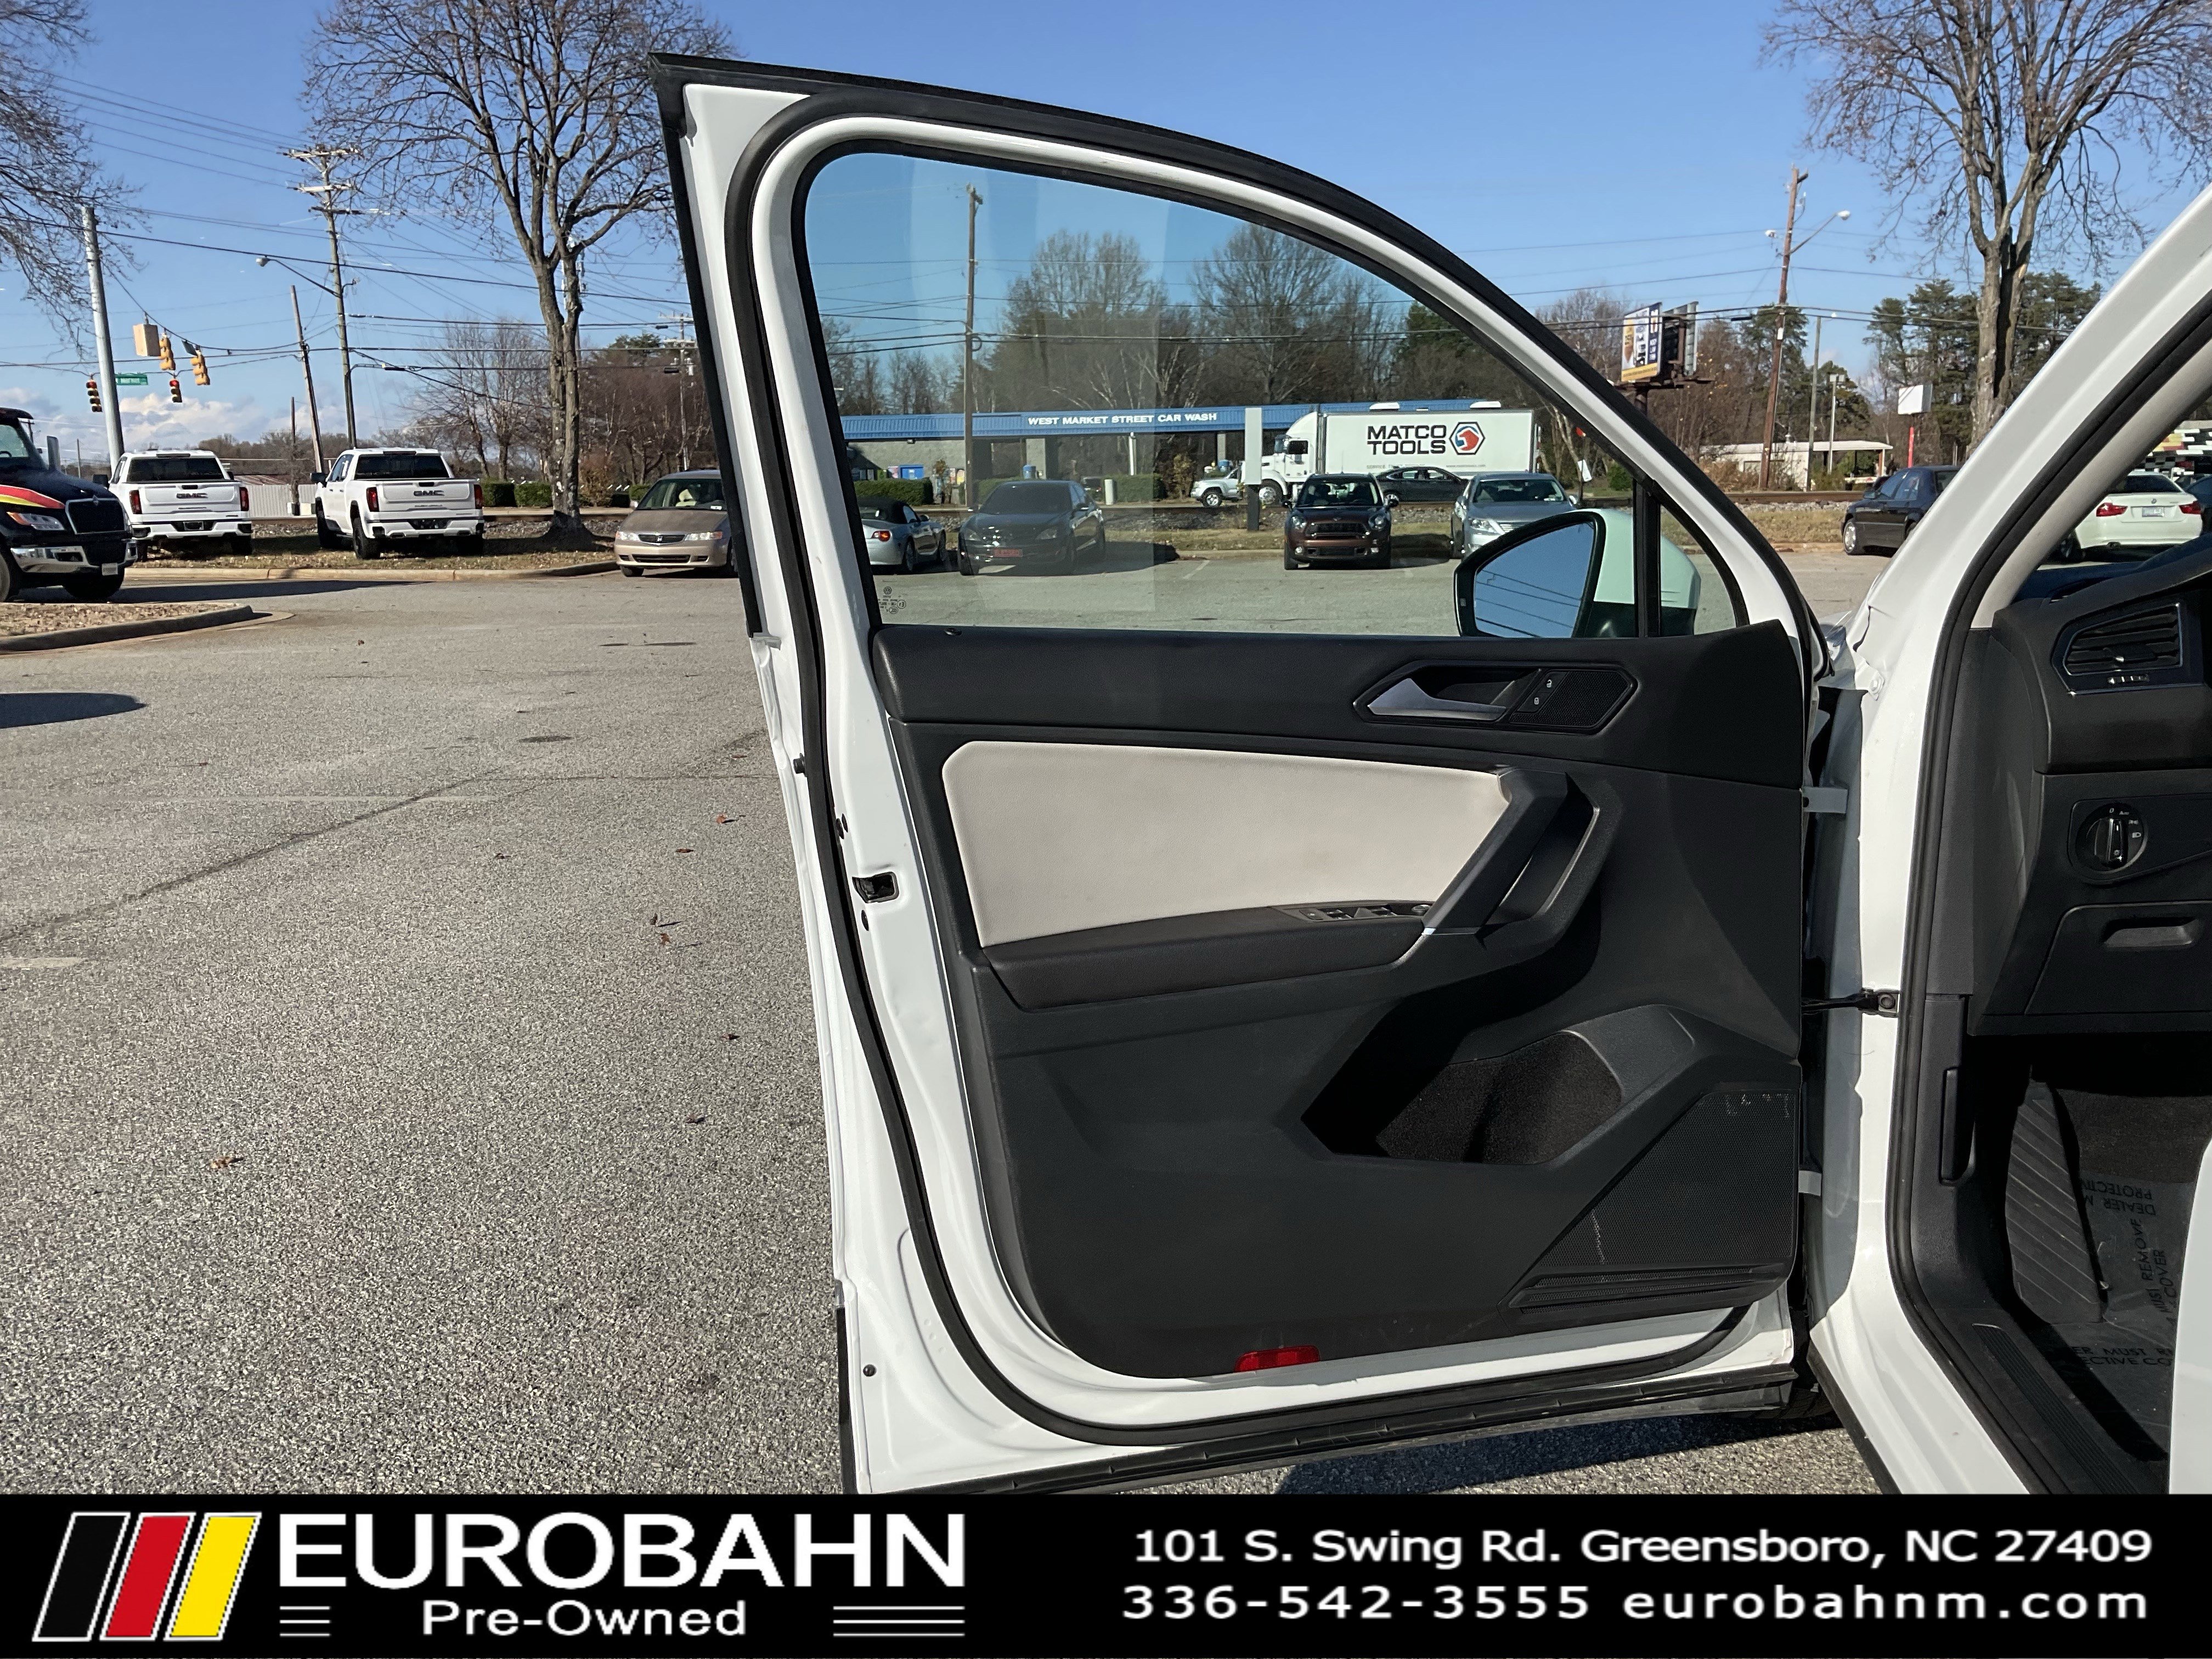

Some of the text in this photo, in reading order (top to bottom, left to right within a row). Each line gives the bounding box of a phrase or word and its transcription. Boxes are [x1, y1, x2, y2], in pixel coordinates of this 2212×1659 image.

[1028, 417, 1059, 425] WEST
[1062, 416, 1108, 425] MARKET
[1158, 414, 1181, 422] CAR
[1184, 413, 1217, 421] WASH
[1368, 425, 1447, 439] MATCO
[1367, 440, 1446, 455] TOOLS
[2103, 1198, 2157, 1216] DEALER
[2152, 1249, 2177, 1299] COVER
[2102, 1347, 2147, 1356] MUST
[2082, 1357, 2140, 1365] ECTIVE
